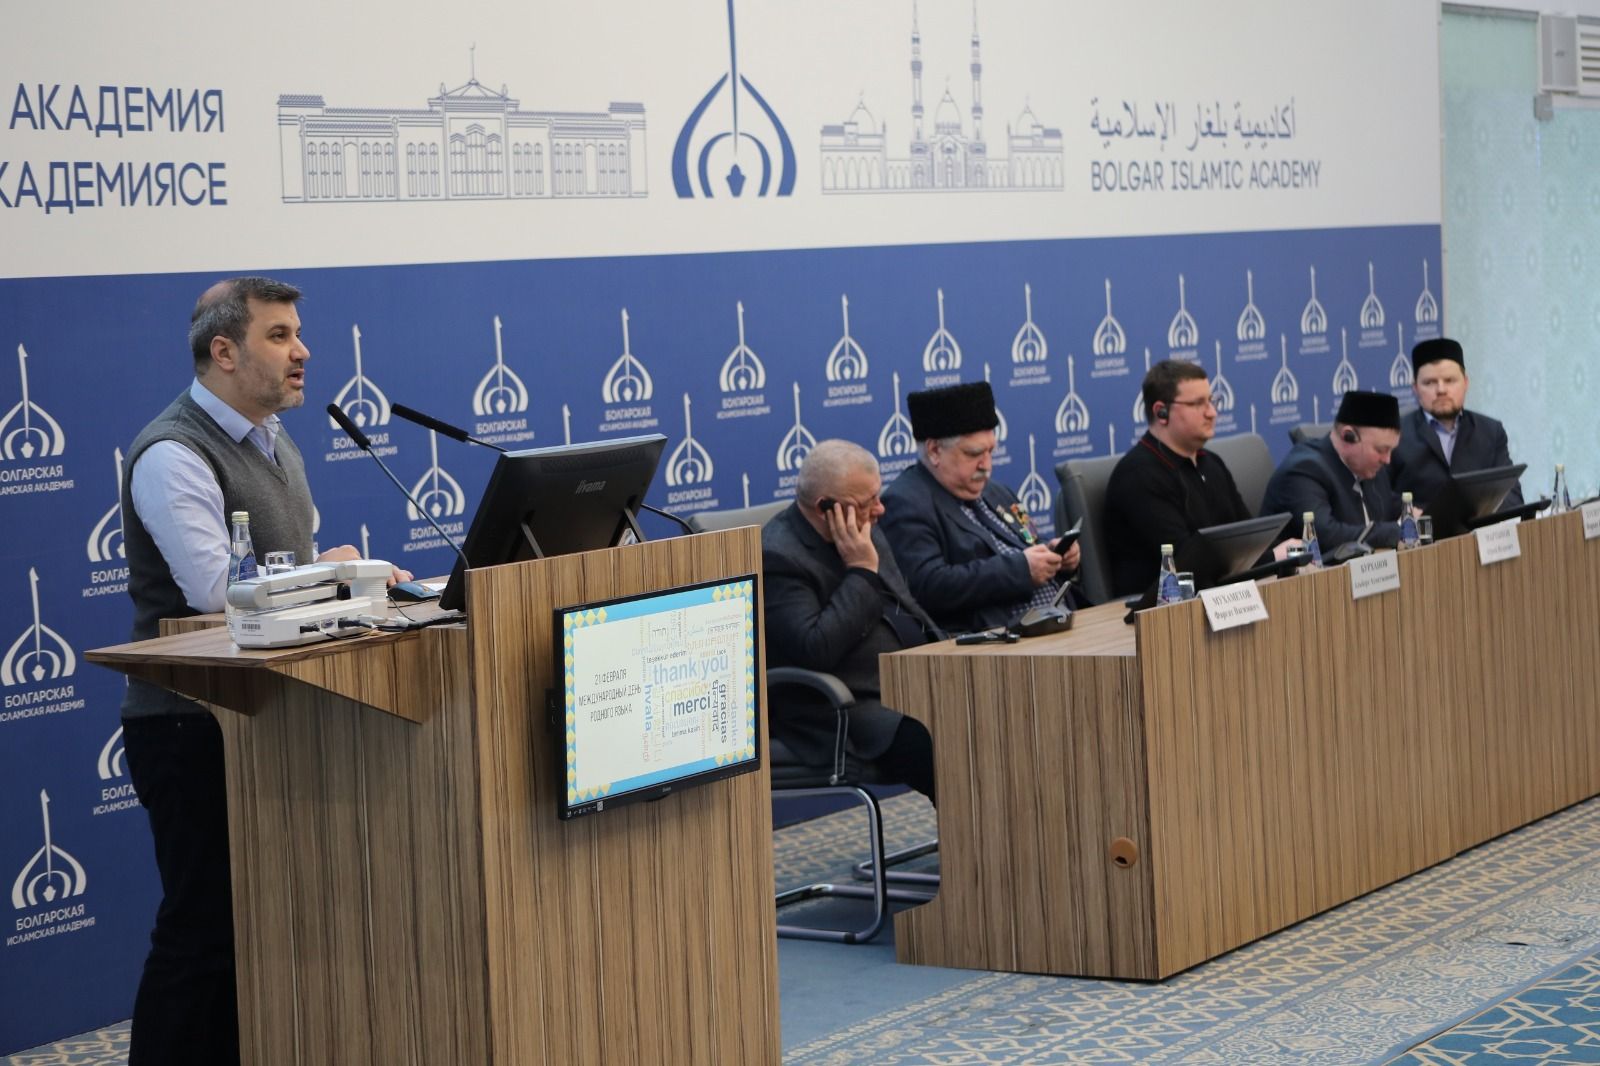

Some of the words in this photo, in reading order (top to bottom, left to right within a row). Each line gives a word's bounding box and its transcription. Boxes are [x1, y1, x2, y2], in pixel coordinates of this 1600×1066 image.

[9, 83, 224, 138] АКАДЕМИЯ
[1091, 97, 1177, 152] الإسلامية
[1186, 101, 1228, 151] بلغار
[1234, 97, 1296, 150] أكاديمية
[1091, 161, 1165, 192] BOLGAR
[1171, 160, 1244, 190] ISLAMIC
[1249, 159, 1321, 189] ACADEMY
[476, 419, 527, 434] БОЛГАРСКАЯ
[333, 433, 389, 449] БОЛСКАЯ
[0, 465, 63, 482] ОЛГАРСКАЯ
[0, 484, 33, 495] АМСКАЯ
[34, 480, 74, 492] АКАДЕМИЯ
[91, 568, 130, 583] БОЛГАР
[594, 673, 601, 686] 21
[602, 668, 627, 683] ФЕВРАЛЯ
[653, 657, 697, 685] thank
[701, 654, 729, 681] you
[5, 686, 74, 708] БОЛГАРСКАЯ
[627, 684, 642, 697] ДЕНЬ
[664, 681, 708, 705] спасибо
[0, 706, 44, 722] СЛАМСКАЯ
[45, 699, 85, 714] АКАДЕМИЯ
[590, 707, 614, 722] РОДНОГО
[614, 703, 633, 718] ЯЗЫКА
[644, 683, 654, 732] hvala
[673, 691, 711, 717] merci
[719, 683, 729, 744] gracias
[102, 784, 137, 801] БОЛГА
[16, 903, 85, 931] БОЛГАРСКАЯ
[7, 926, 55, 946] ИСЛАМСКАЯ
[56, 916, 96, 934] АКАДЕМИЯ
